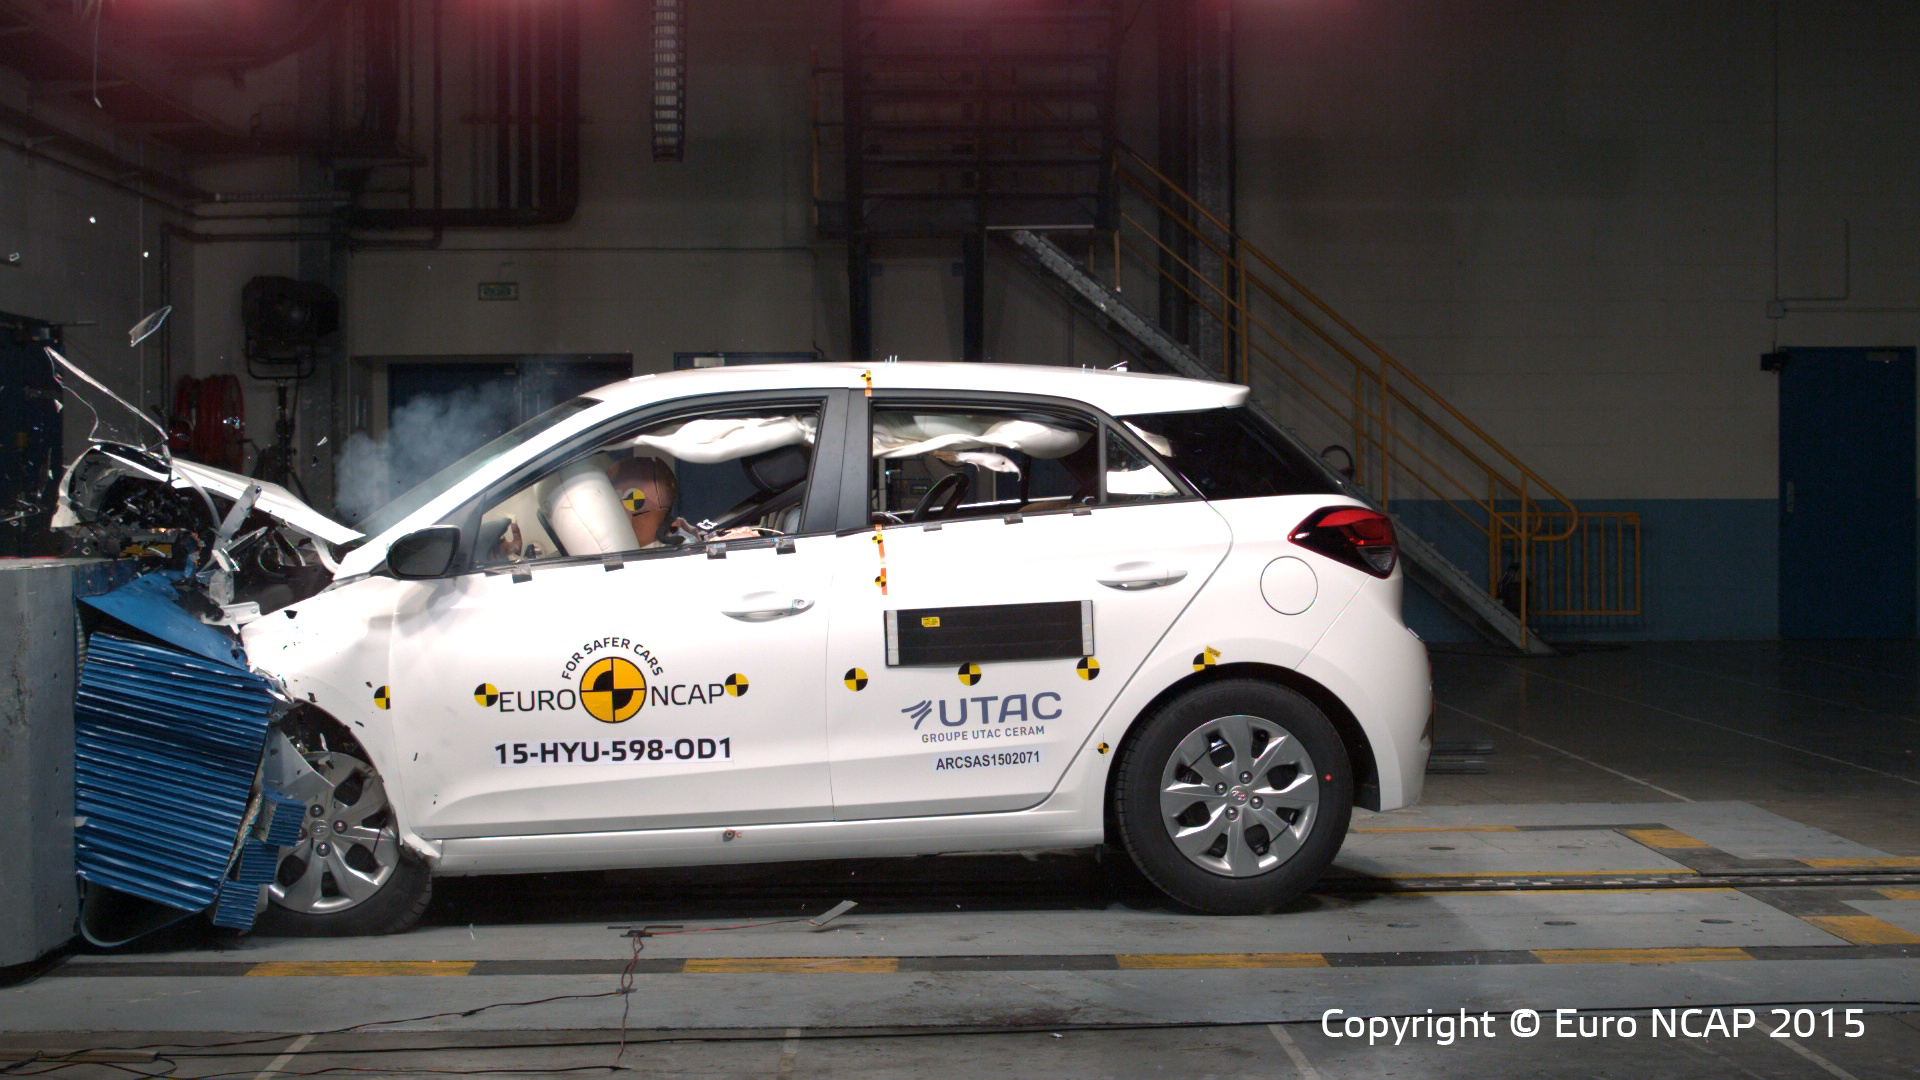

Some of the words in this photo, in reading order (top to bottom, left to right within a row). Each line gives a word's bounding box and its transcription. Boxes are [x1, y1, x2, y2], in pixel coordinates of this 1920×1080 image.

[561, 652, 585, 680] FOR
[583, 637, 631, 655] SAFER
[633, 643, 664, 676] CARS
[499, 689, 577, 713] EURO
[651, 683, 725, 706] NCAP
[938, 691, 1063, 727] UTAC
[921, 731, 968, 744] GROUPE
[972, 729, 1001, 740] UTAC
[1005, 726, 1045, 737] CERAM
[494, 737, 731, 765] 15-HYU-598-OD1
[936, 750, 1040, 771] ARCSAS1502071
